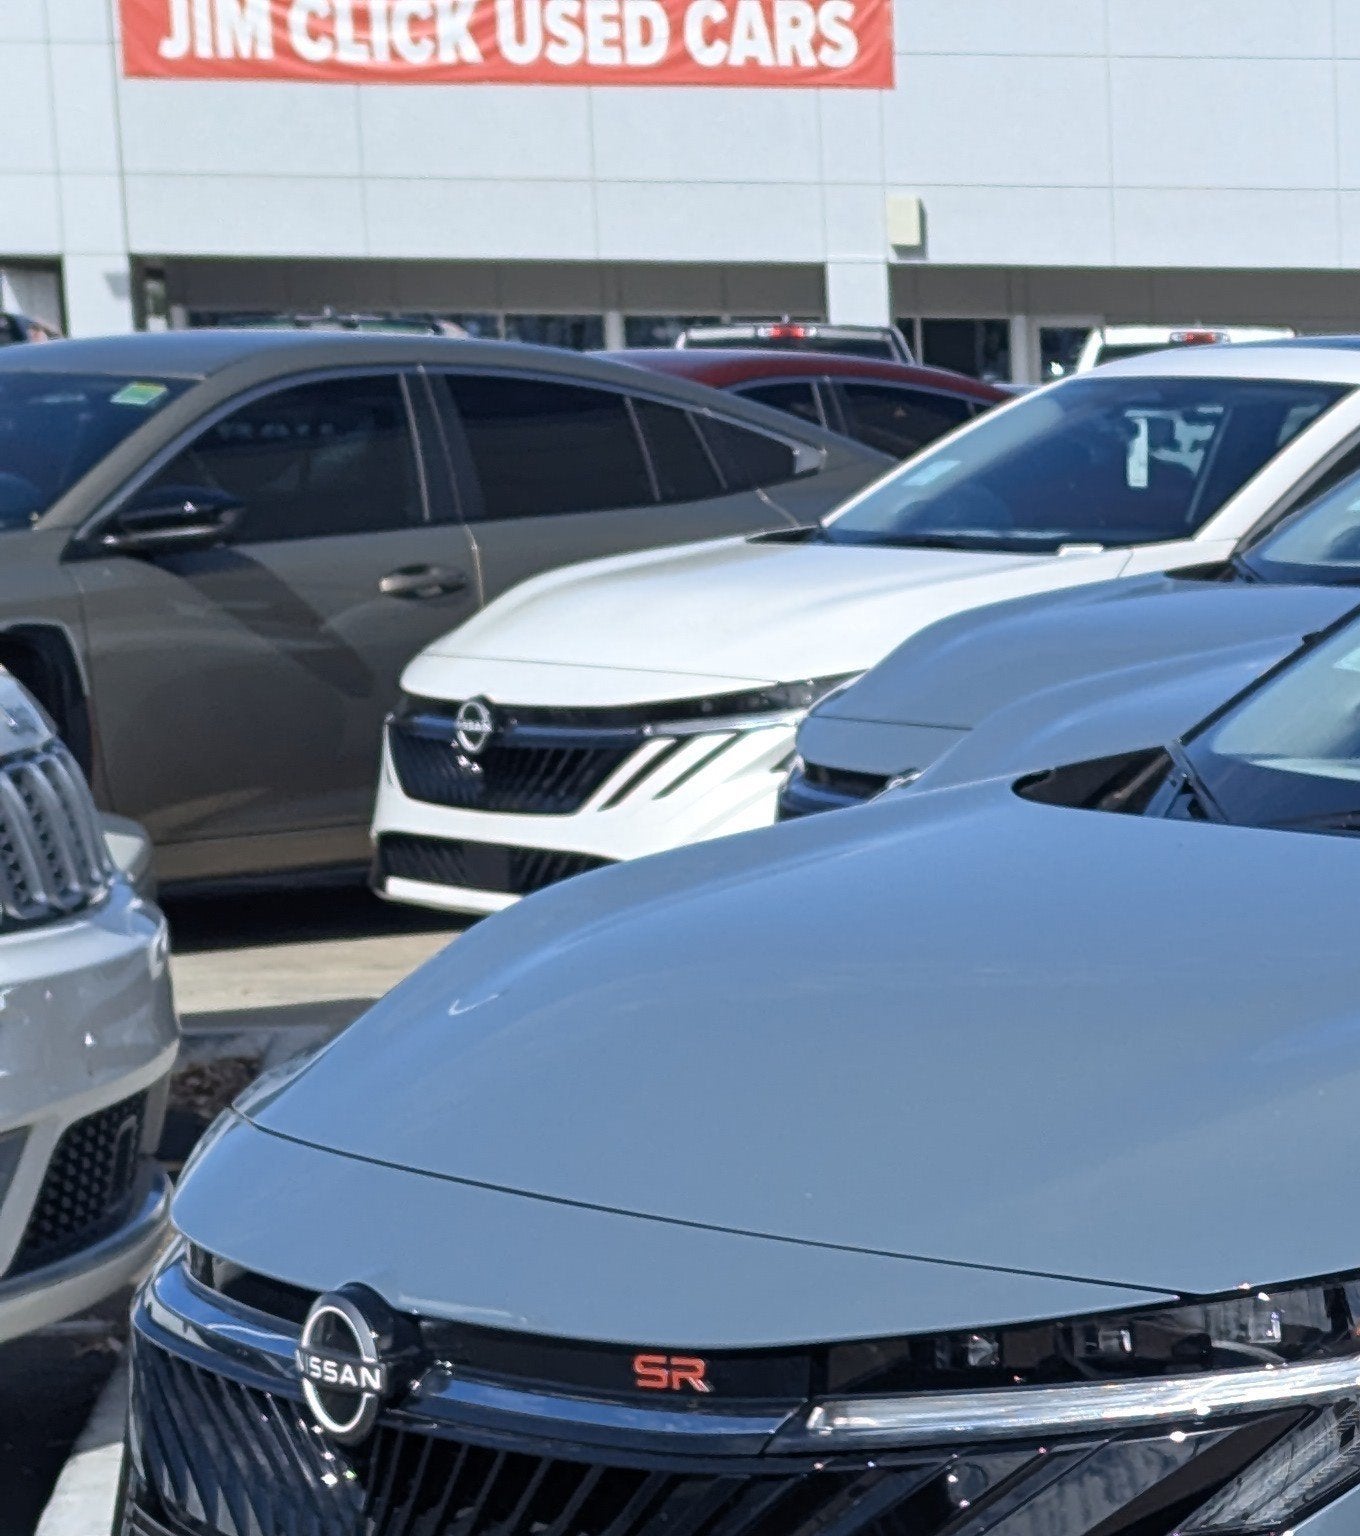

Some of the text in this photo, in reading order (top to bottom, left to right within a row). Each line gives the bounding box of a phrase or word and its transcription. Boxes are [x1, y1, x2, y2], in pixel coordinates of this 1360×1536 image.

[158, 0, 859, 68] JIM CLICK USED CARS
[632, 1354, 713, 1393] SR
